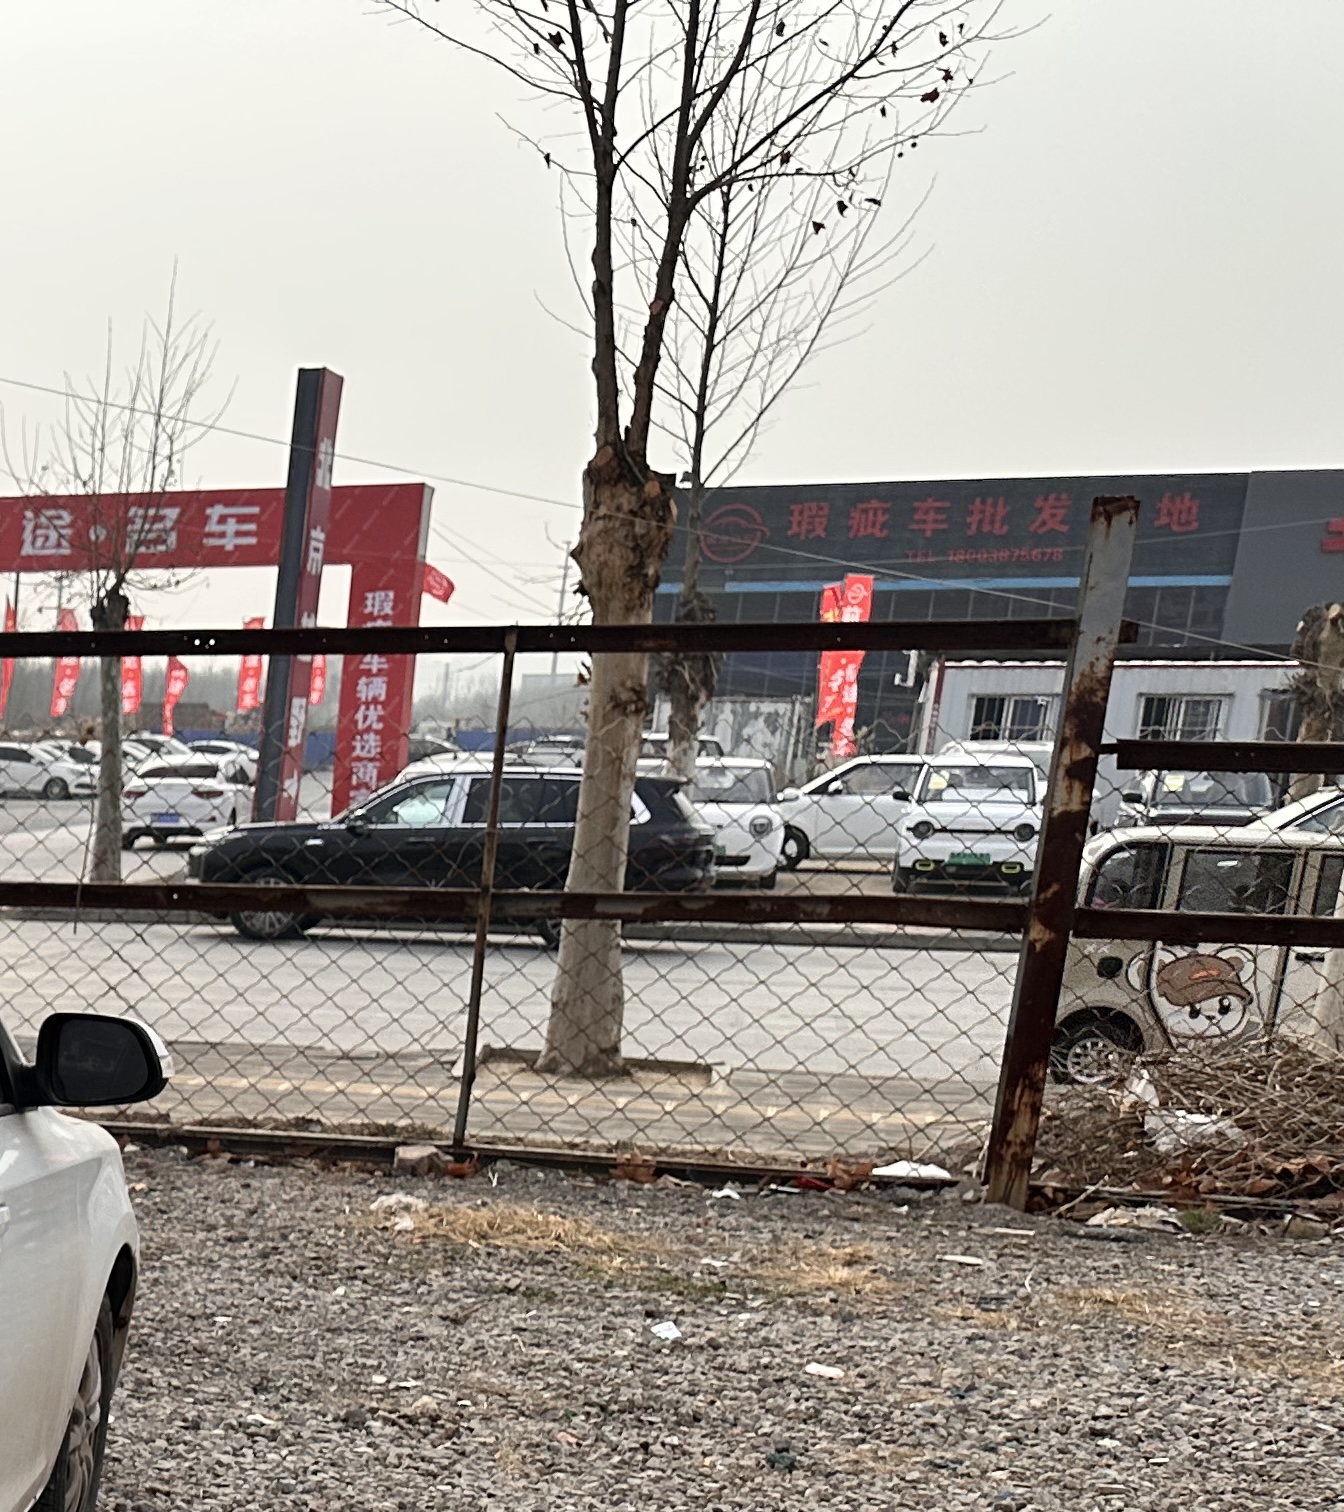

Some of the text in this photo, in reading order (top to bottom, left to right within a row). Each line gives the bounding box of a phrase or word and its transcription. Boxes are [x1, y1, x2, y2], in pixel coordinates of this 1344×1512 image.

[787, 491, 1200, 541] 瑕疵车批发地
